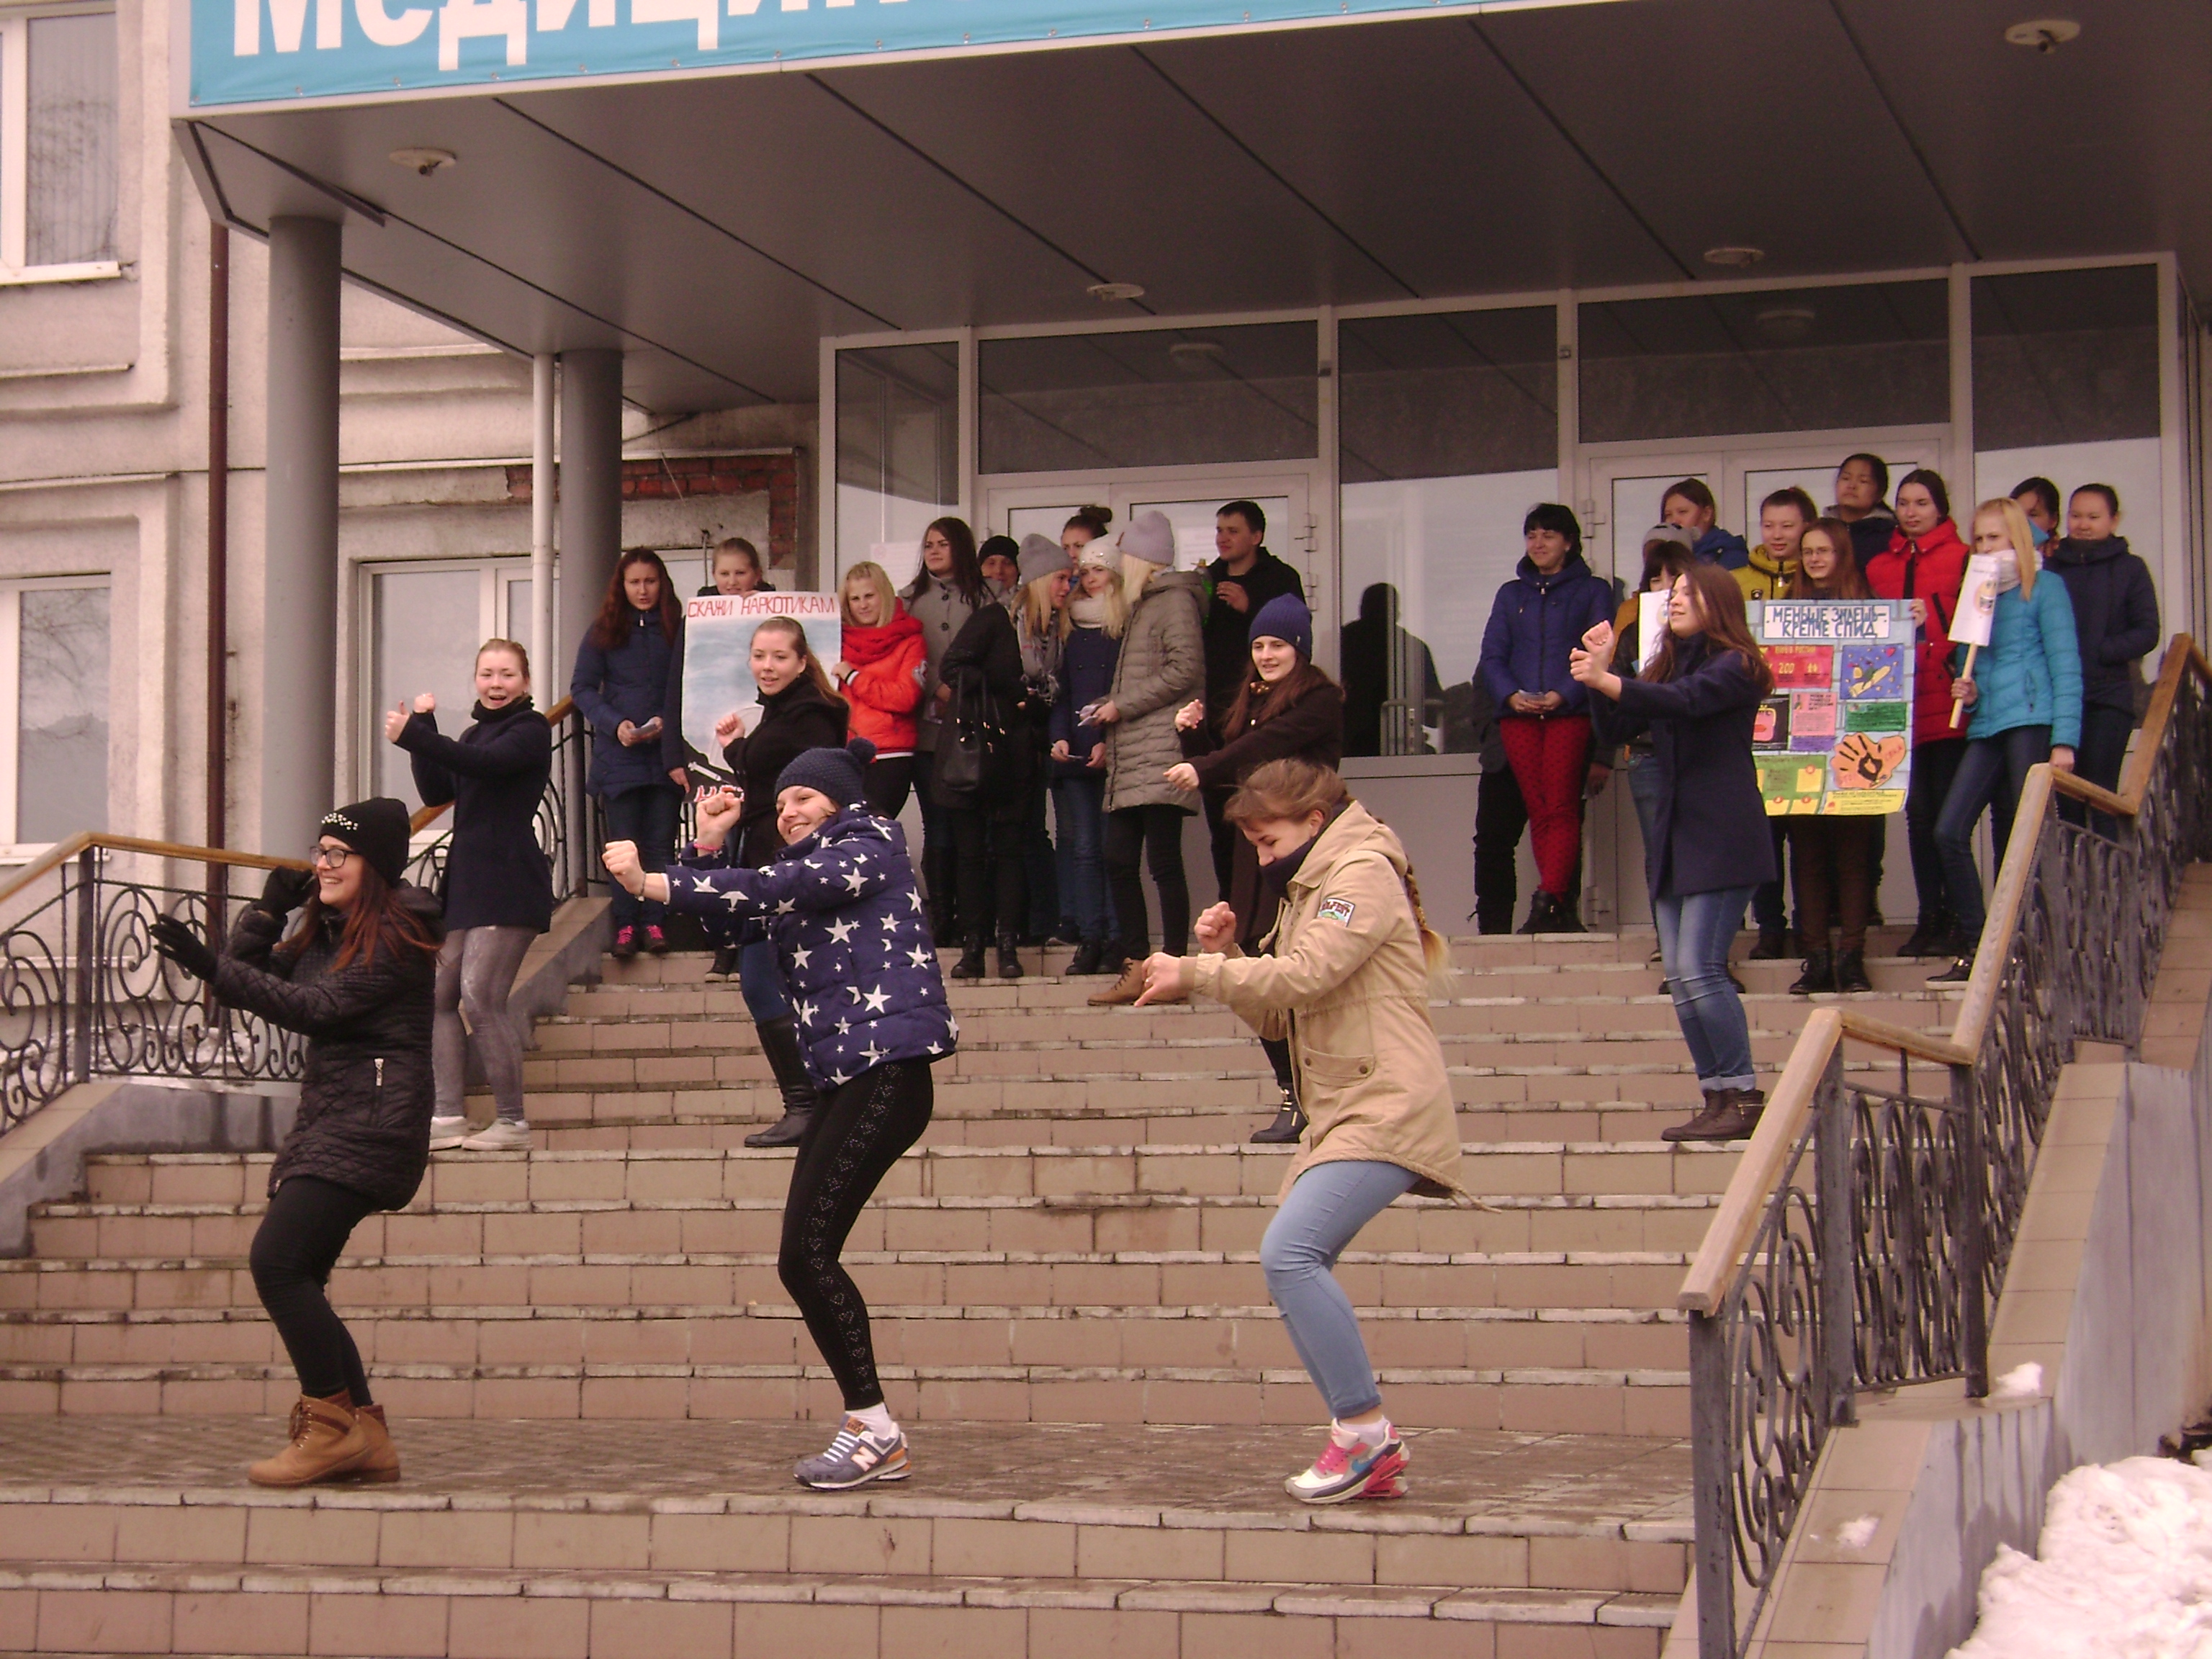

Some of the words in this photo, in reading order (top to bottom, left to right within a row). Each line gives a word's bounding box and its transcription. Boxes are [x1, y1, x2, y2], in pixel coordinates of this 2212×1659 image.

[688, 601, 733, 618] СКАЖИ
[741, 596, 835, 615] НАРКОТИКАМ
[1773, 607, 1829, 622] МЕНЬШЕ
[1782, 621, 1829, 638] КРЕПЧЕ
[1835, 621, 1878, 639] СПИД
